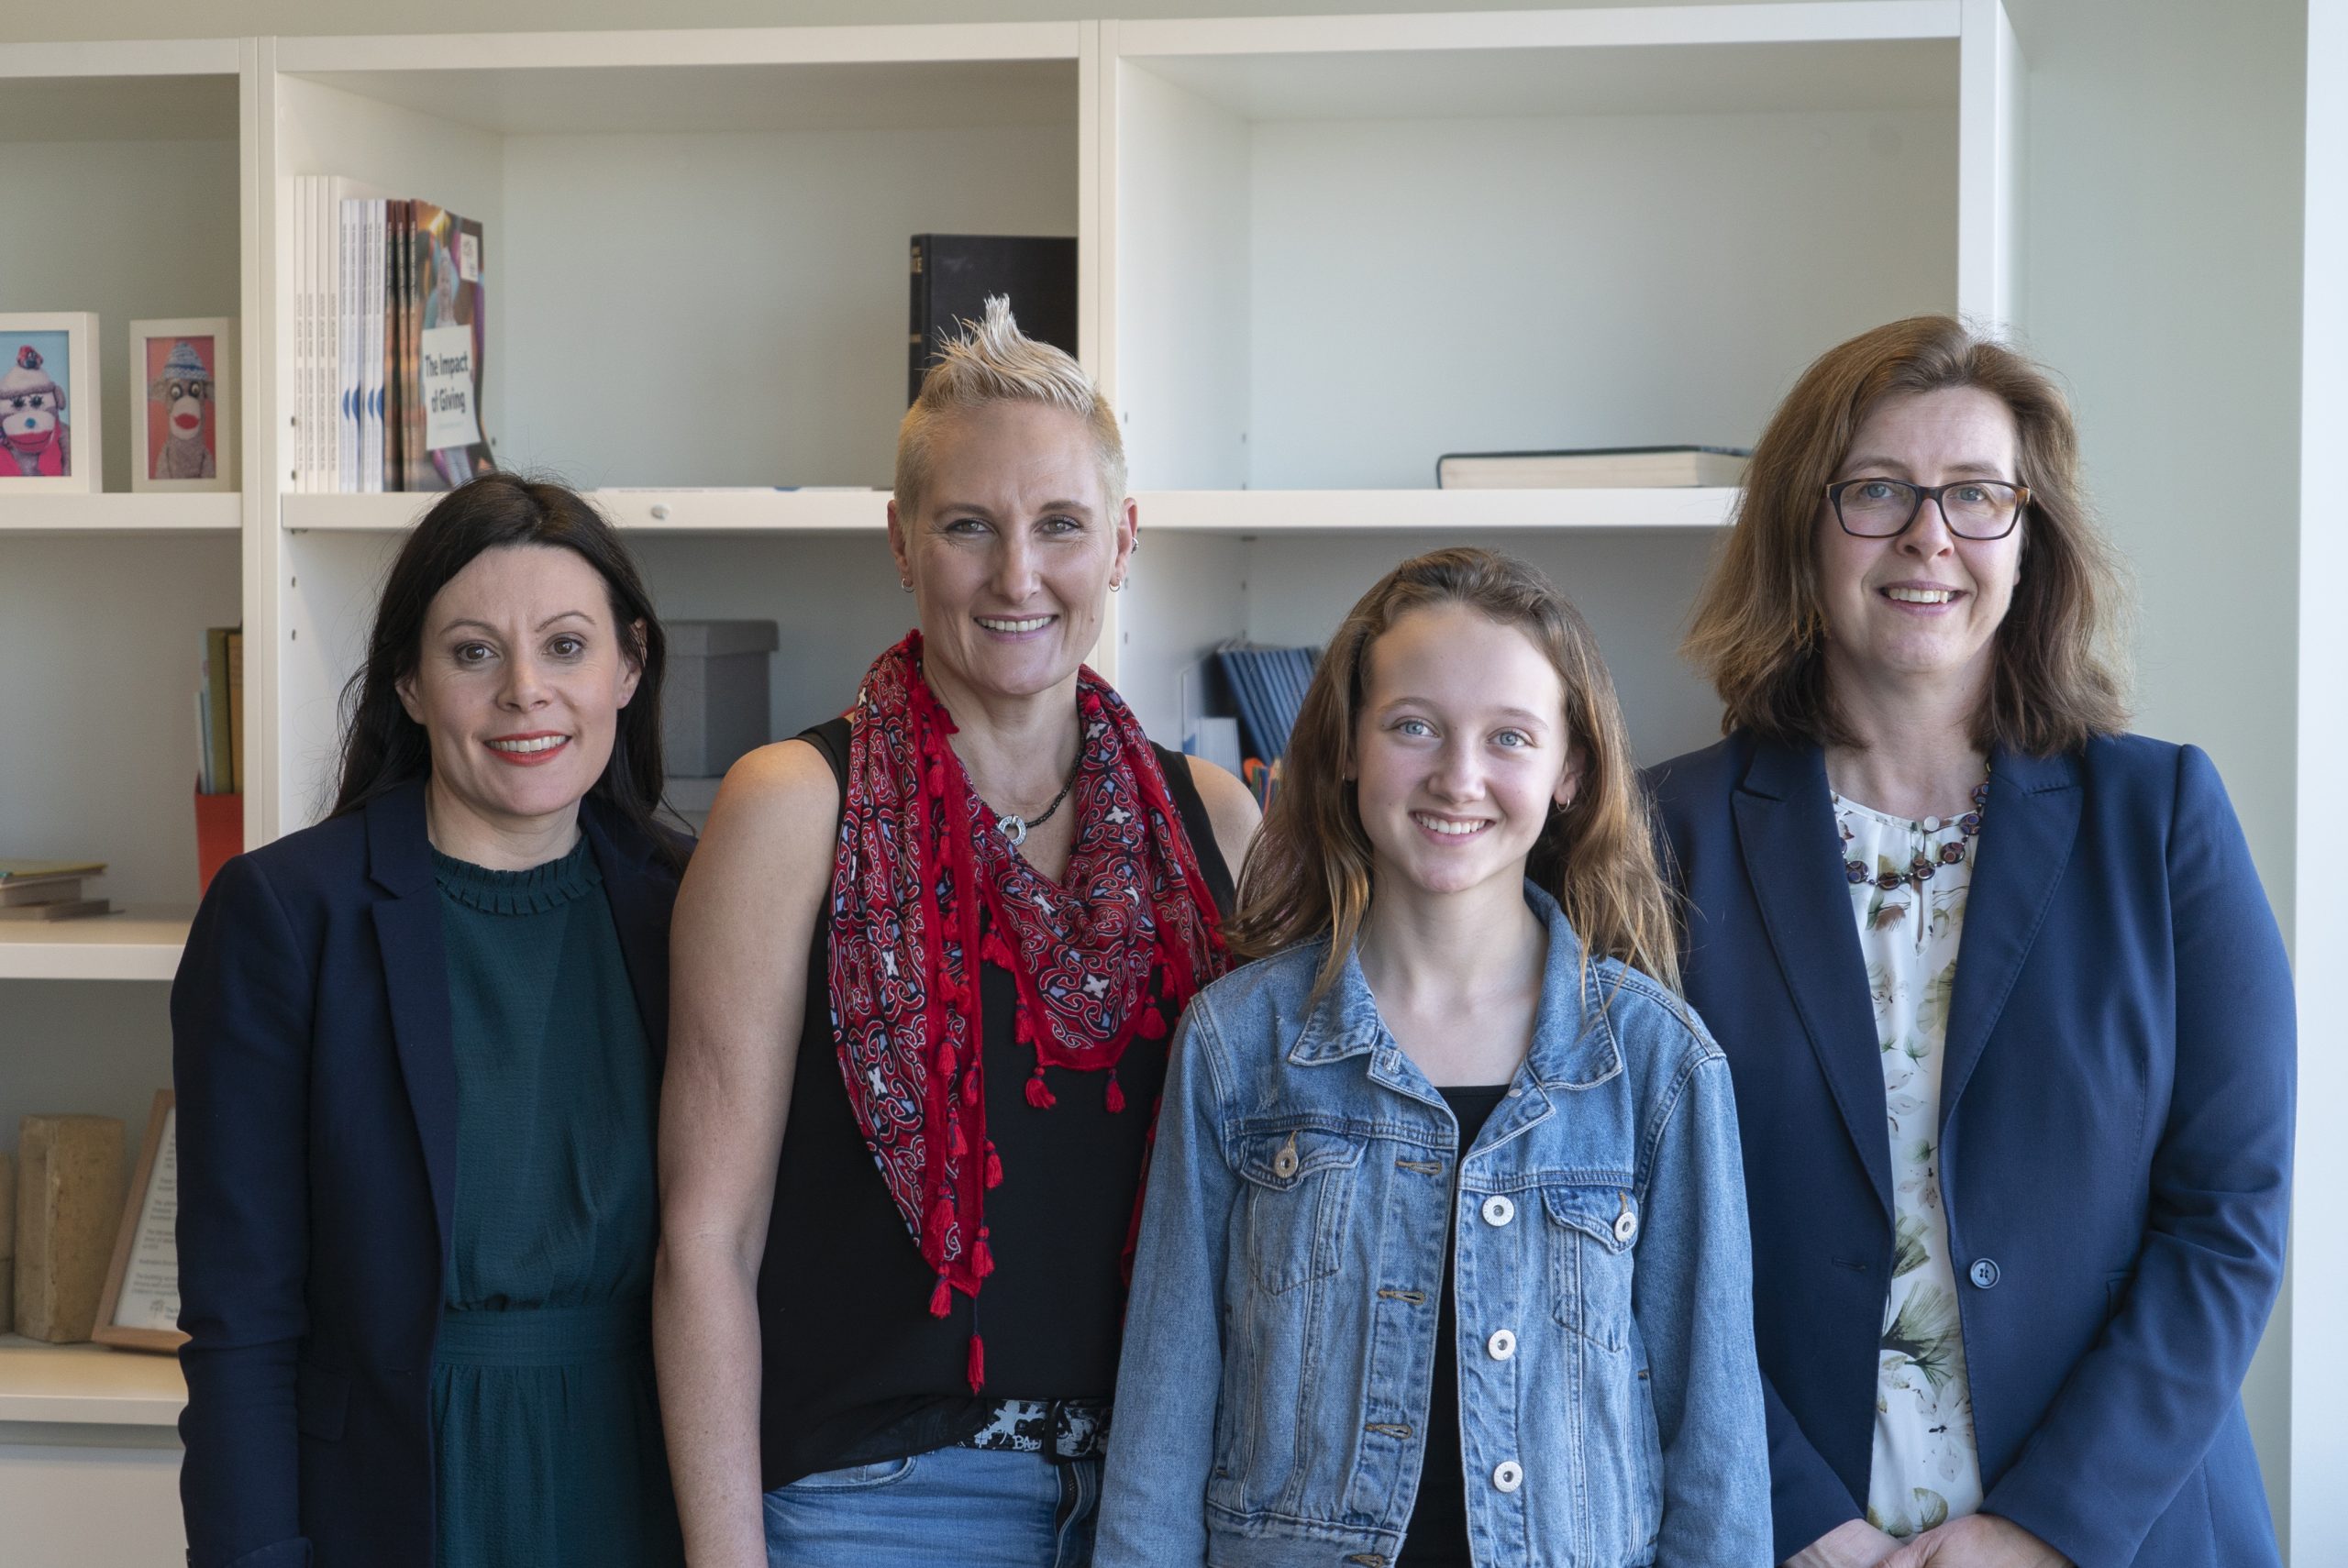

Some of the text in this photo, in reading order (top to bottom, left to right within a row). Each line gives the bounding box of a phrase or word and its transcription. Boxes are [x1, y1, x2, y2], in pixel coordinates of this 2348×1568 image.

[425, 351, 469, 379] The Impact
[431, 387, 466, 414] of Giving
